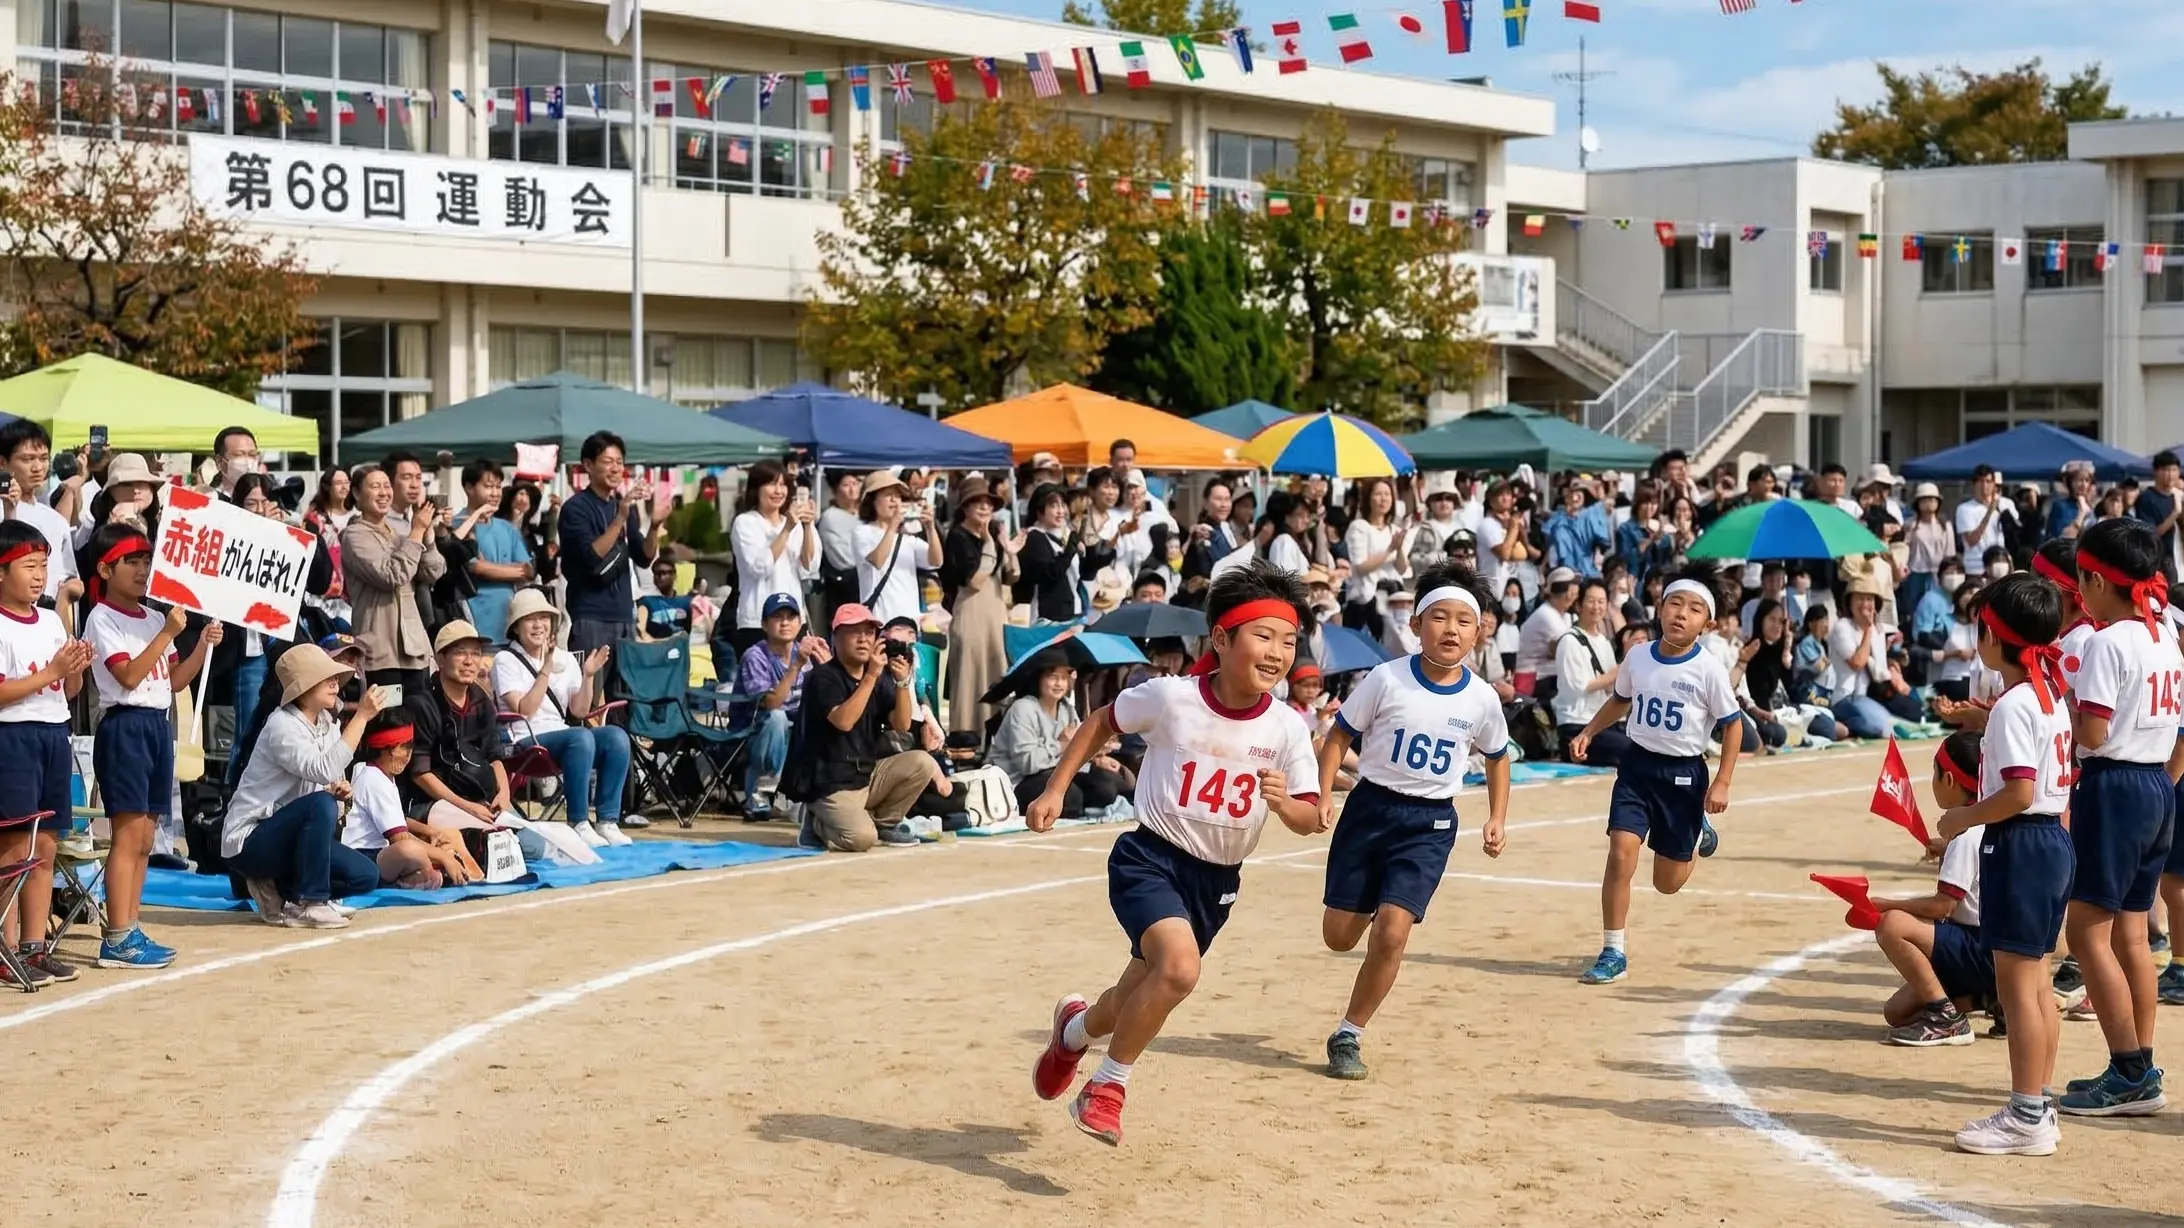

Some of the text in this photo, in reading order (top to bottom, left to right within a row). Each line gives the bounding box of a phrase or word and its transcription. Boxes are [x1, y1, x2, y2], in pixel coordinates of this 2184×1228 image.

[1637, 693, 1685, 732] 165
[1390, 728, 1456, 776] 165
[1178, 760, 1257, 819] 143
